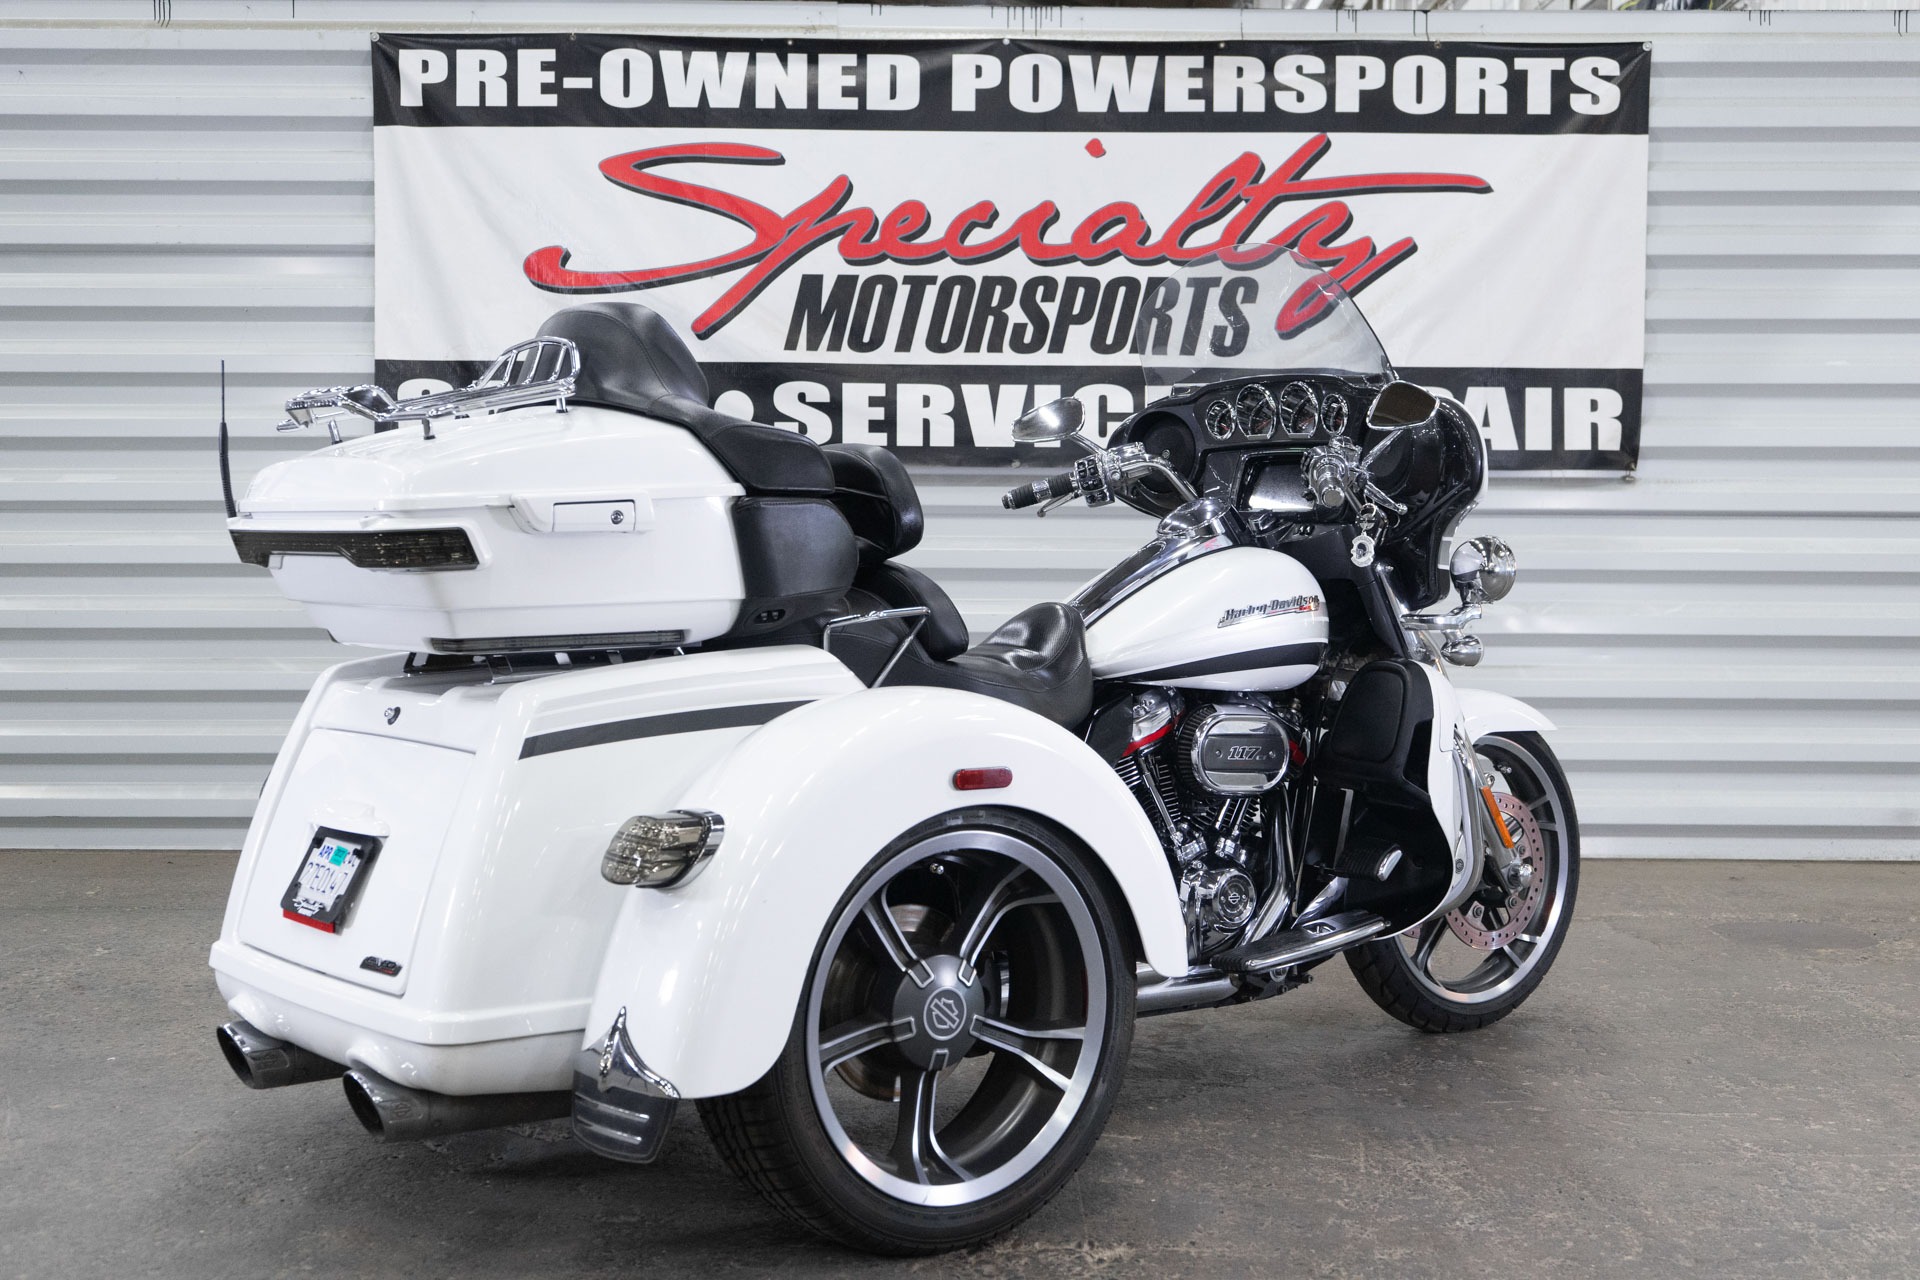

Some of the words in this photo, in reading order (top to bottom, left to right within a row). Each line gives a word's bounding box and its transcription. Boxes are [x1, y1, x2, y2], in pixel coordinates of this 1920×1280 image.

[398, 48, 921, 111] PRE-OWNED
[952, 53, 1622, 116] POWERSPORTS
[523, 133, 1493, 340] Specialty
[784, 273, 1259, 357] MOTORSPORTS
[1432, 386, 1623, 451] AIR
[1228, 746, 1262, 760] 117
